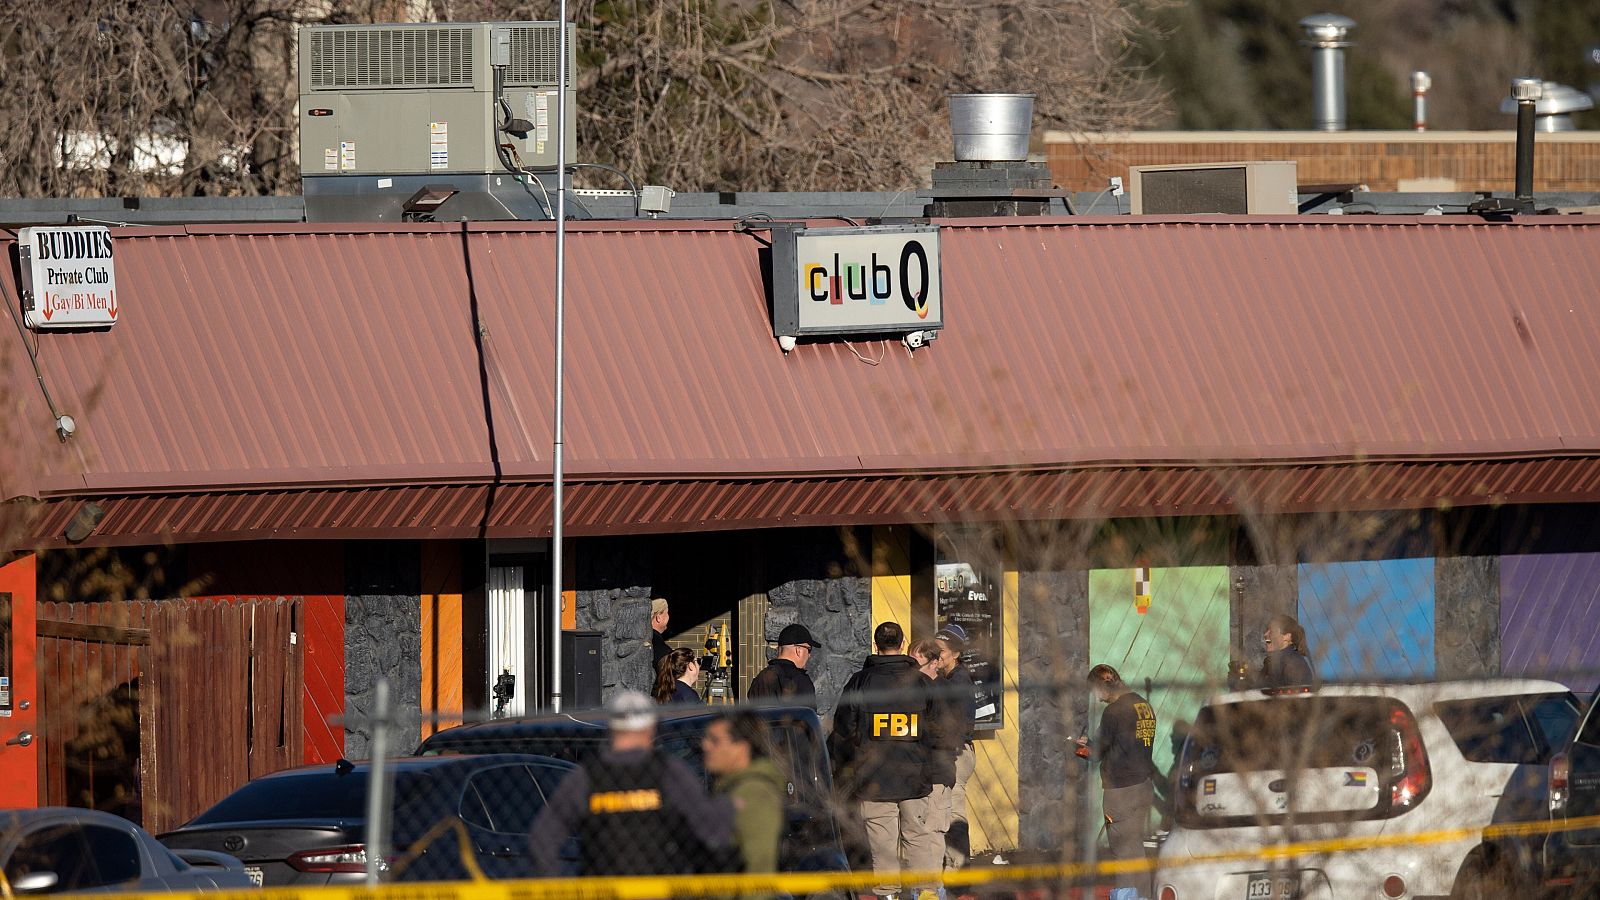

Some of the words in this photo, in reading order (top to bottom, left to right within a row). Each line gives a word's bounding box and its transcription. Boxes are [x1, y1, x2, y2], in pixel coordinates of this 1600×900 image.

[36, 231, 113, 260] BUDDIES
[47, 267, 83, 285] Private
[85, 267, 109, 284] Club
[52, 293, 84, 312] Gay/Bi
[86, 293, 107, 310] Men
[873, 713, 918, 737] FBI
